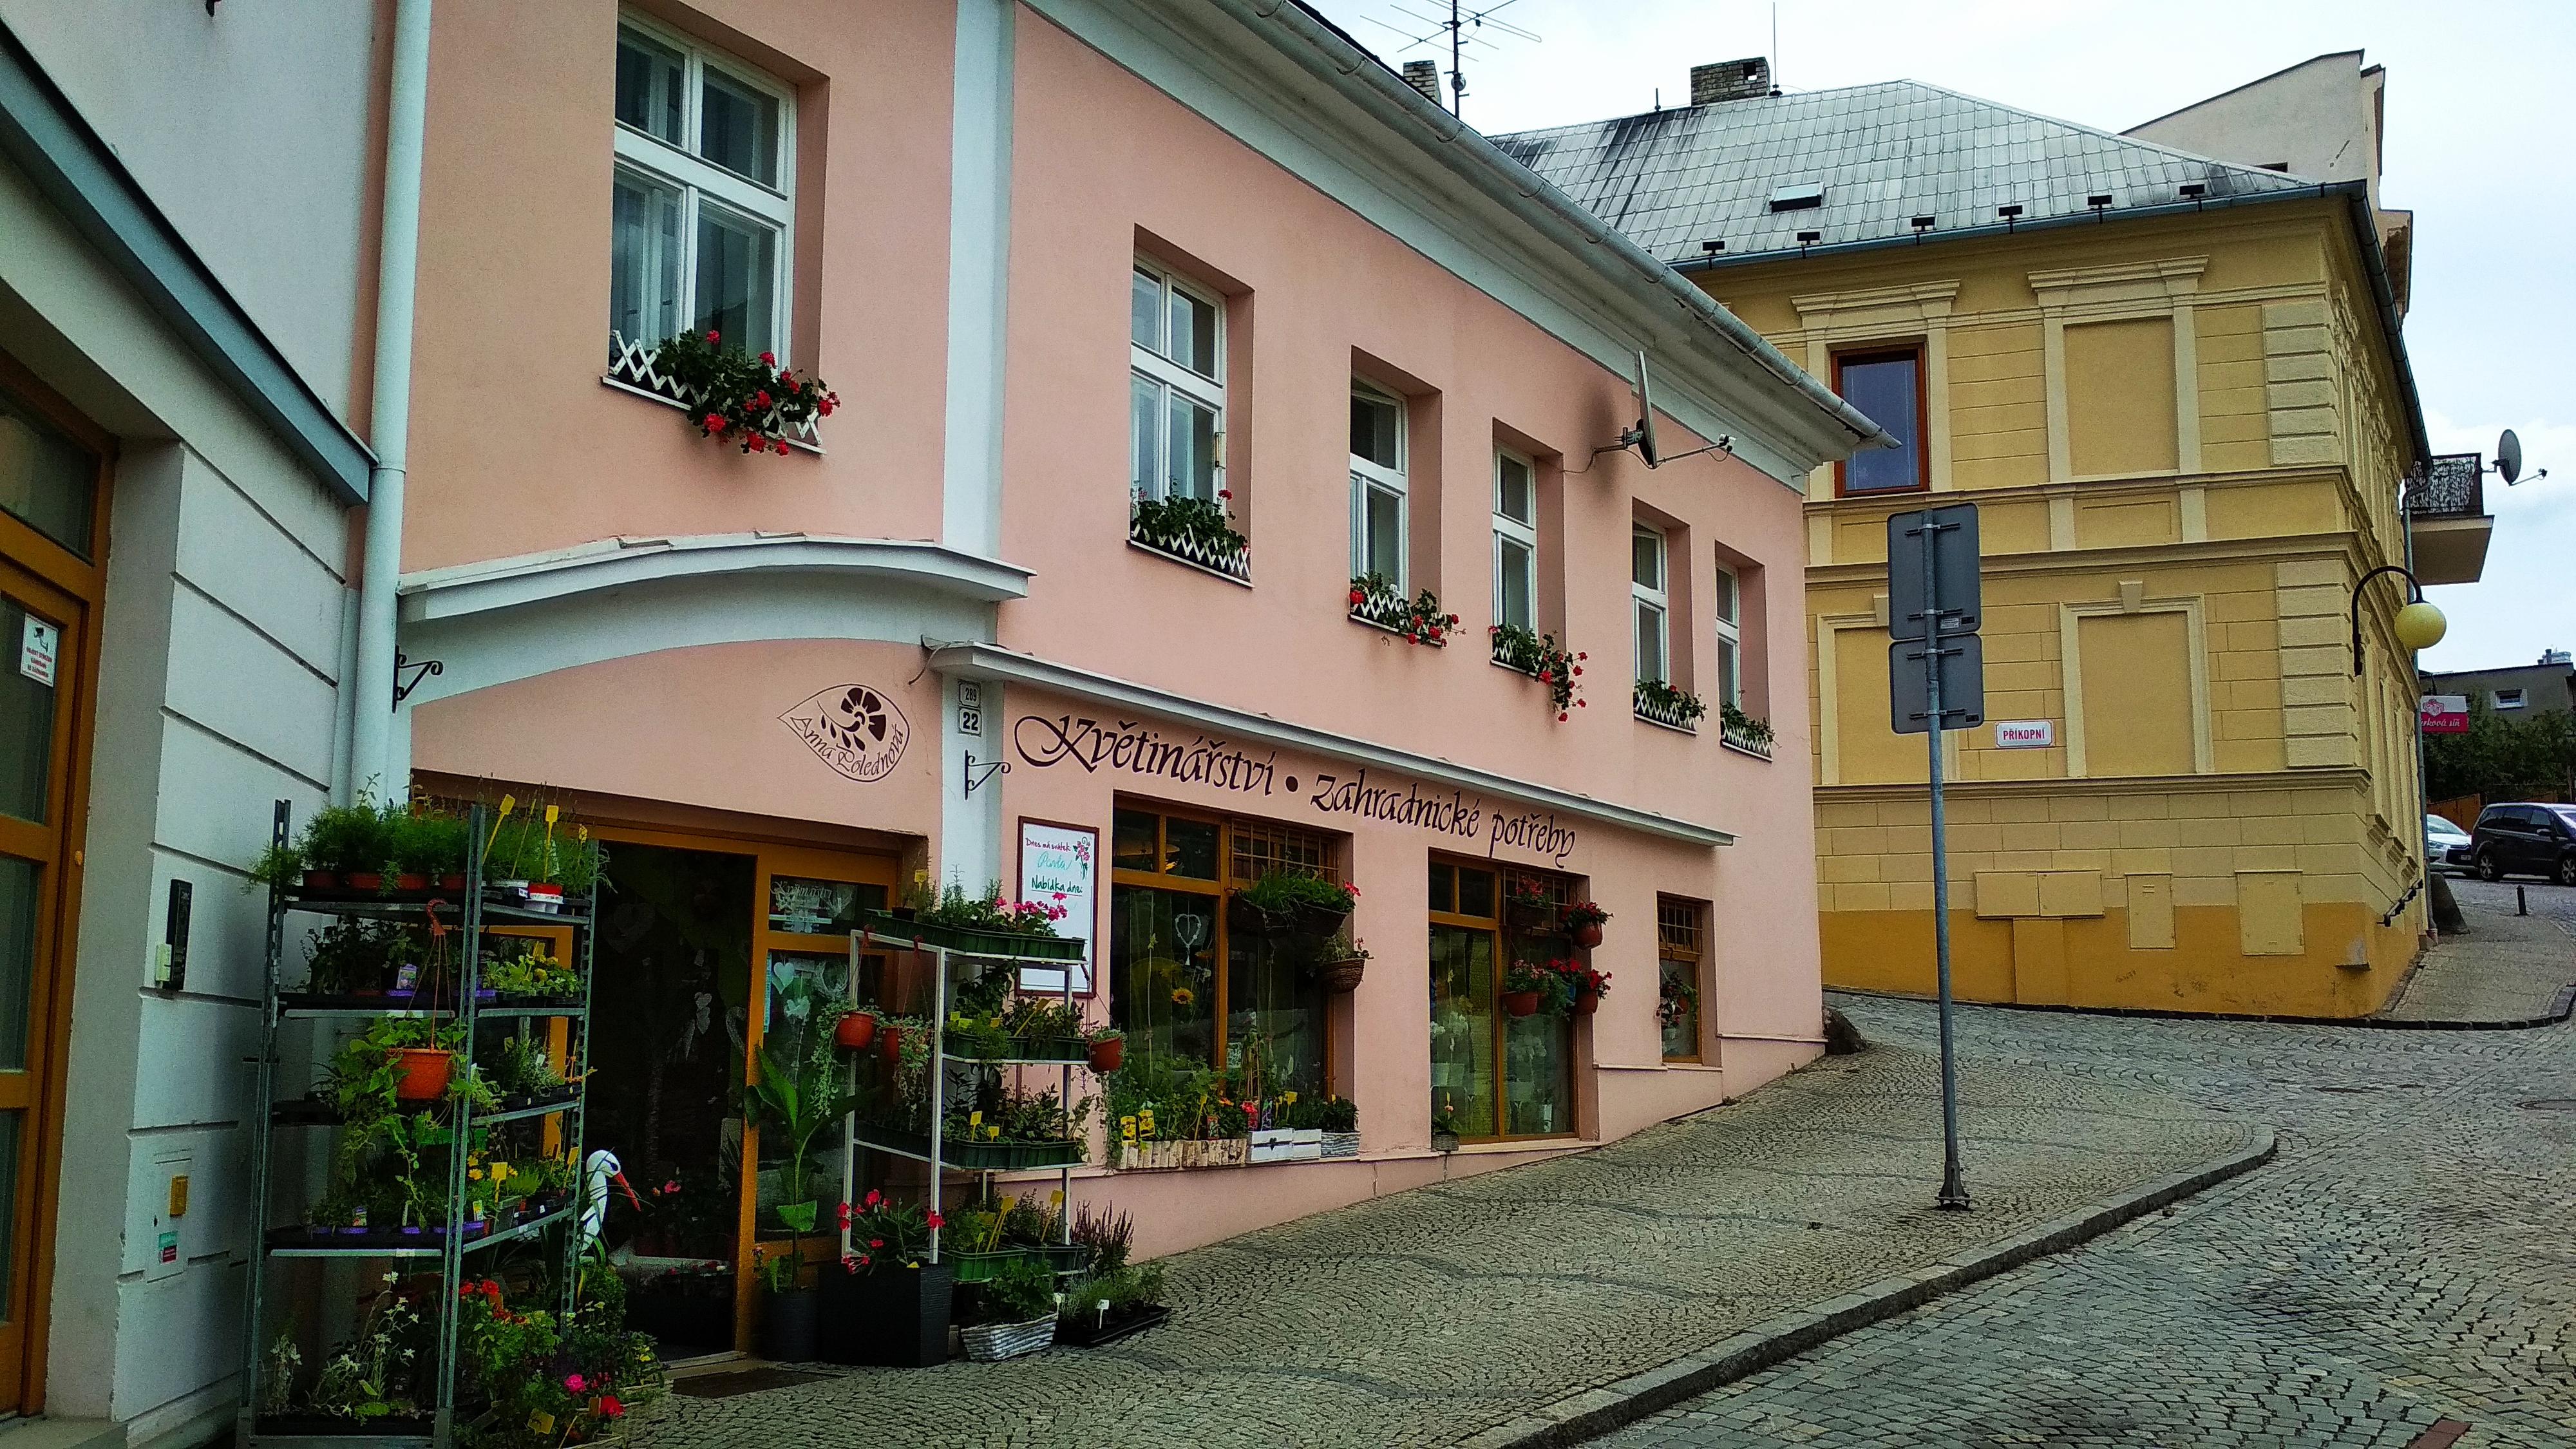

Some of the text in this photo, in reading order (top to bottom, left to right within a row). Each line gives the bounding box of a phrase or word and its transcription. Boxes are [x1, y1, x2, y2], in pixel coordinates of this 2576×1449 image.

[965, 687, 977, 702] 289
[963, 711, 978, 731] 22
[2003, 727, 2045, 741] PŘÍKOPNÍ
[790, 716, 903, 775] Anna Polednová
[1014, 714, 1276, 796] Květinářství
[1489, 809, 1575, 869] potřeby
[1025, 837, 1041, 848] Dnes
[1032, 875, 1065, 892] Nabídka
